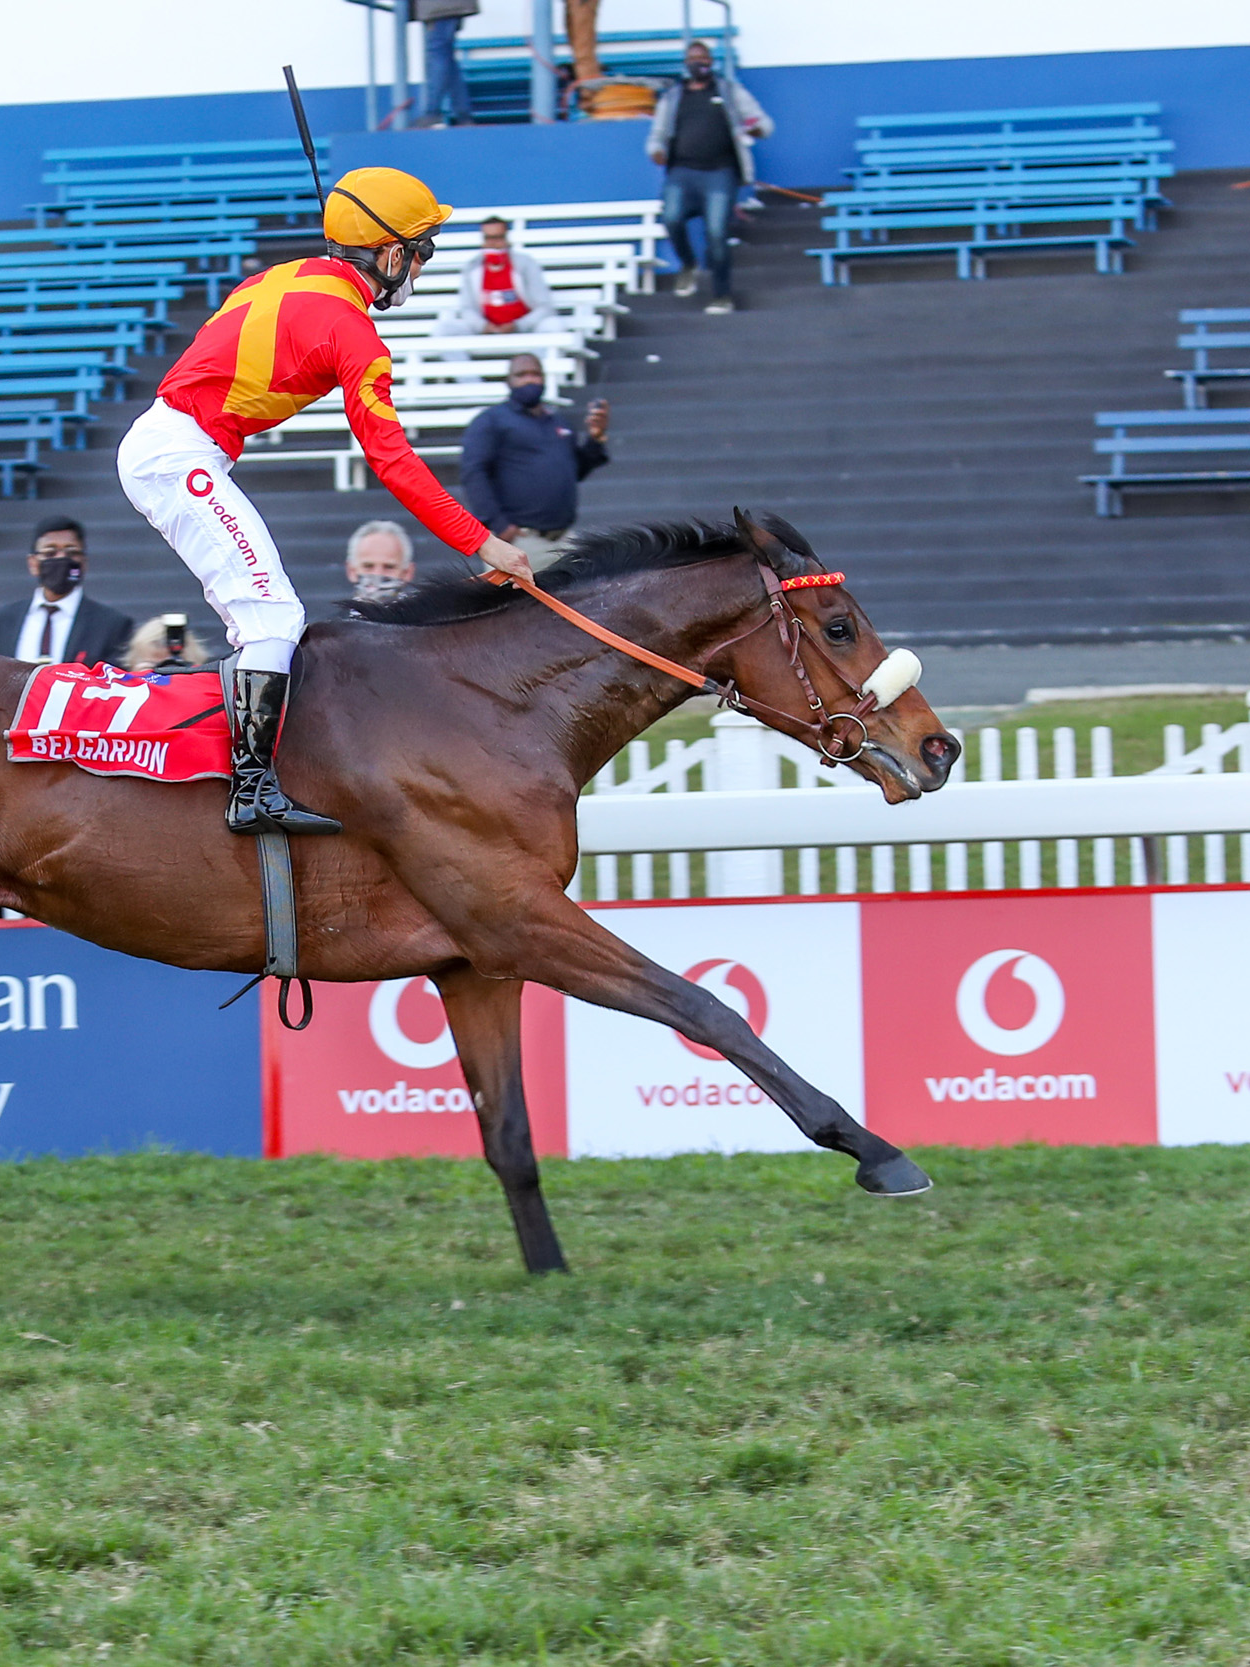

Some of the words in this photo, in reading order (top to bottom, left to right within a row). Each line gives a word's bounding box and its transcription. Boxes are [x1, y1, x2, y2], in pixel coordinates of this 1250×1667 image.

[207, 495, 258, 567] vodacom
[28, 679, 150, 738] 17
[32, 735, 169, 775] BELGARION
[338, 1081, 476, 1114] vodaco
[636, 1077, 774, 1107] vodaco
[924, 1068, 1097, 1102] vodacom
